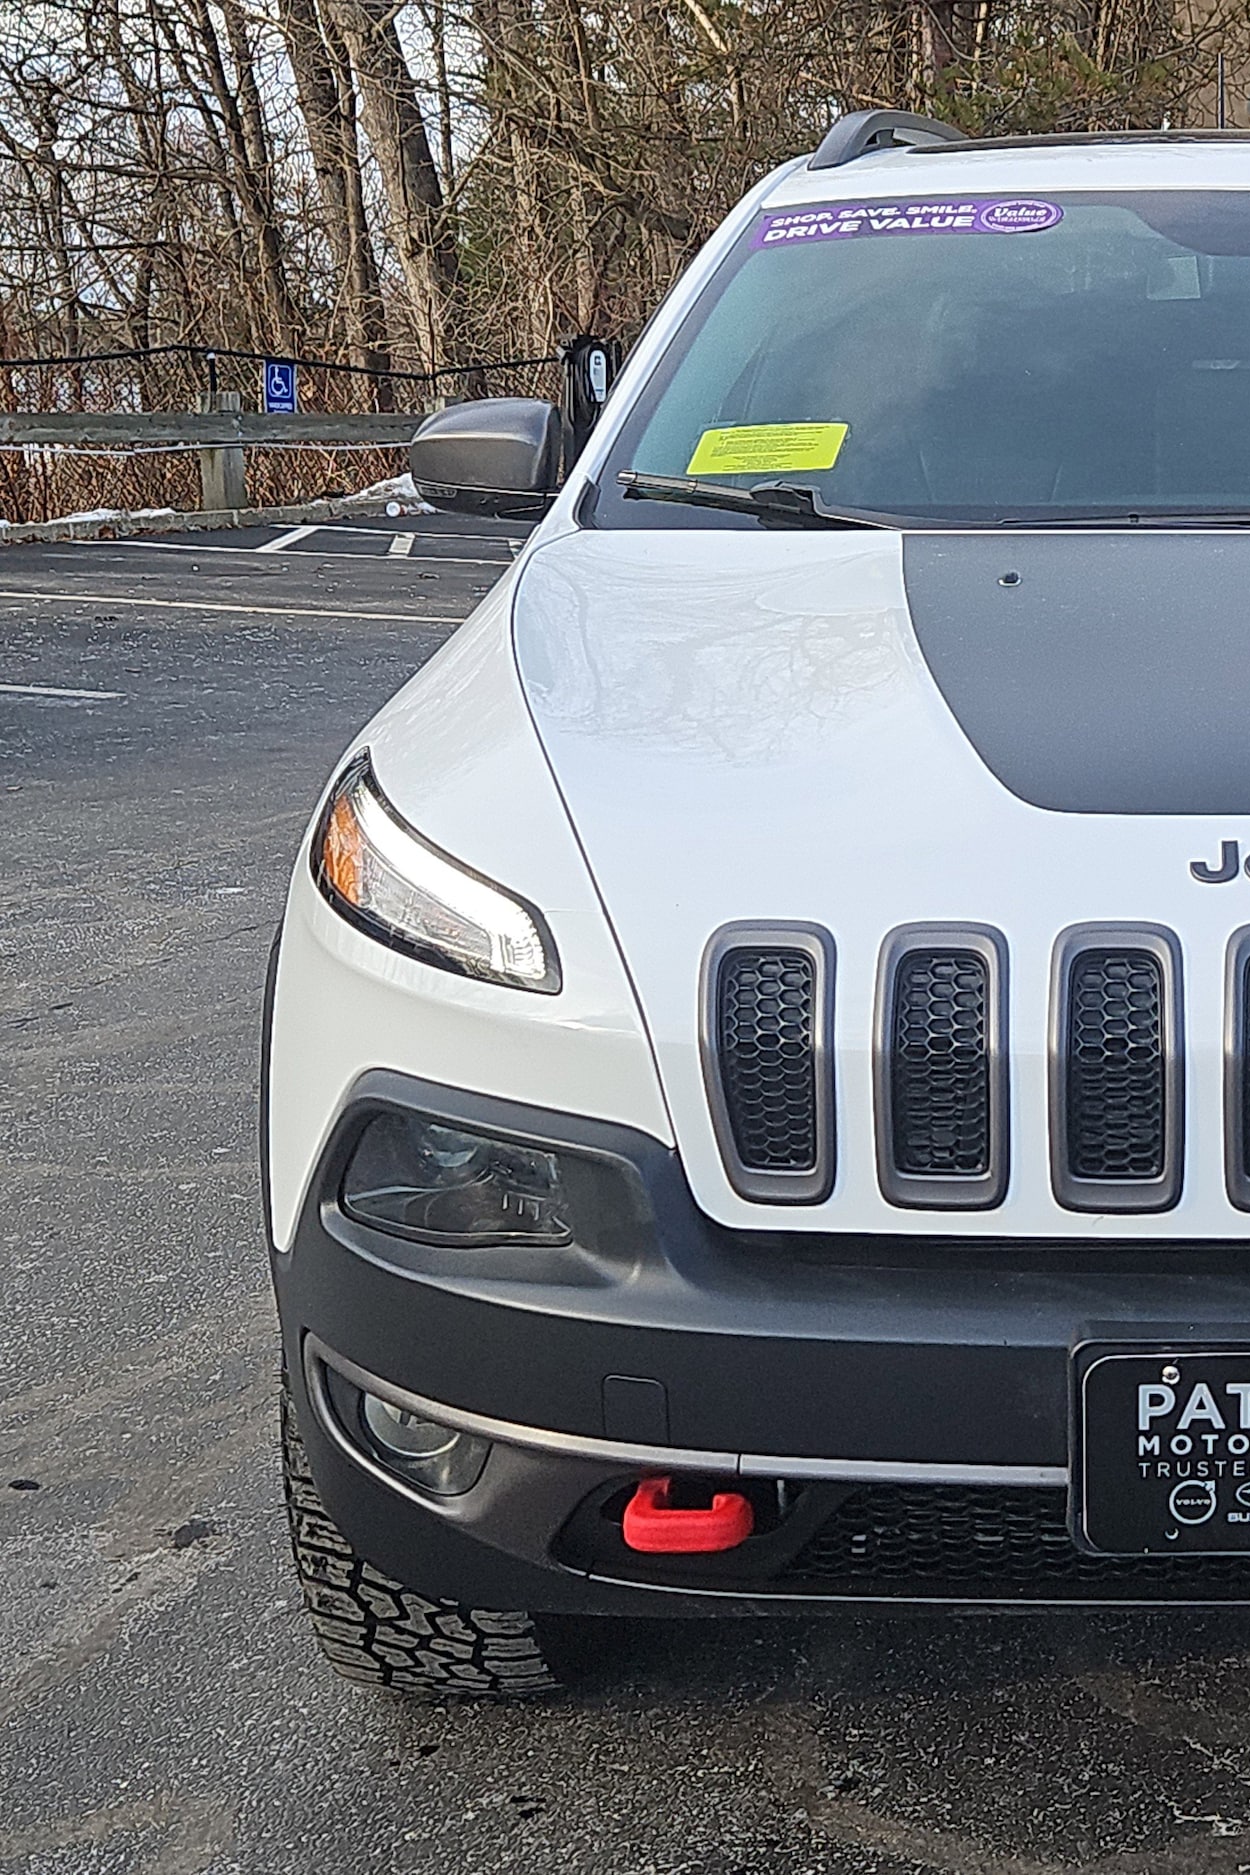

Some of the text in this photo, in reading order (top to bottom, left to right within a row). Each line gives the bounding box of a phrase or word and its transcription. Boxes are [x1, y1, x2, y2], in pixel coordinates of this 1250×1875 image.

[905, 204, 978, 215] SMILE.
[994, 206, 1047, 217] Value
[763, 220, 862, 242] DRIVE
[869, 215, 975, 230] VALUE
